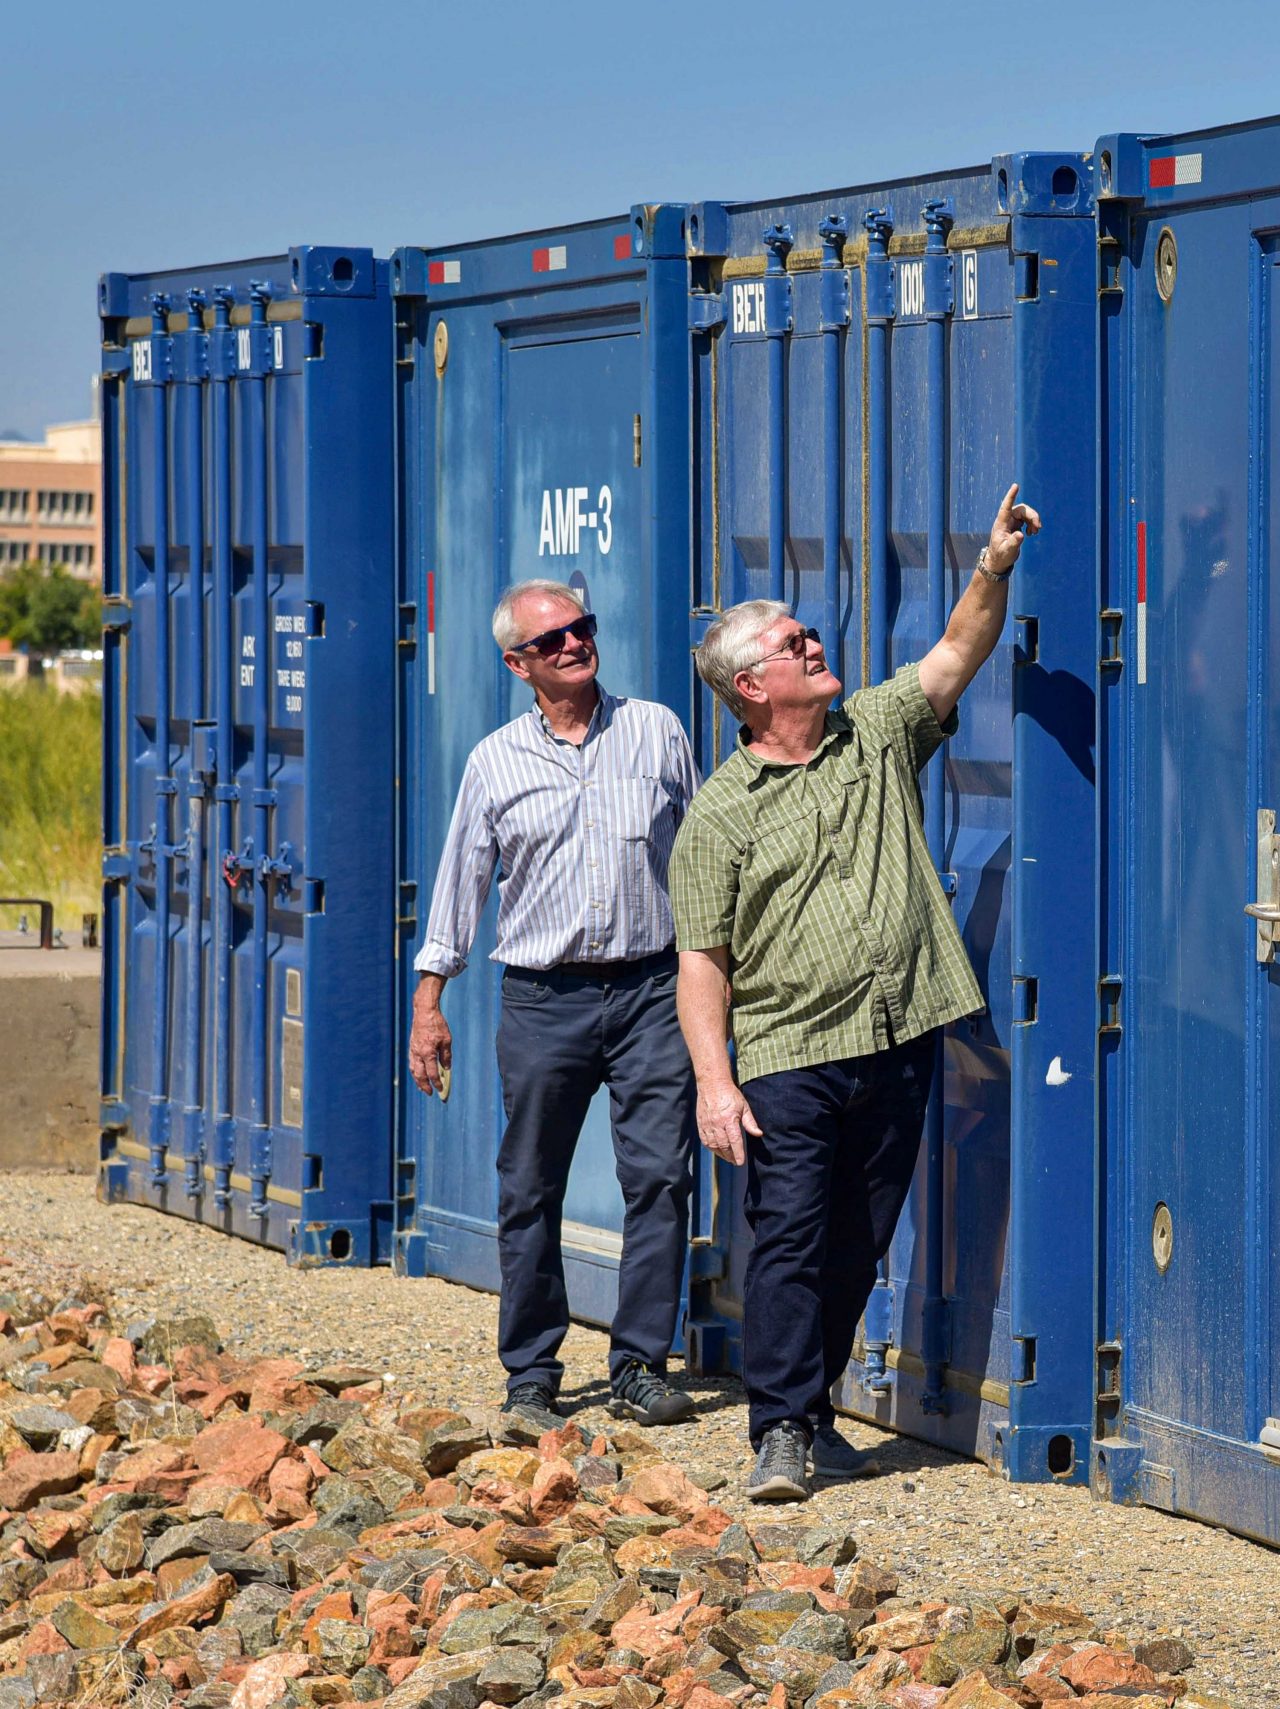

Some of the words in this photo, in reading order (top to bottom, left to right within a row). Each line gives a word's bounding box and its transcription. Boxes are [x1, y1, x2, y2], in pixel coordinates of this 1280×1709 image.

[901, 262, 924, 316] 1001
[538, 485, 613, 556] AMF-3
[240, 664, 255, 686] ENT
